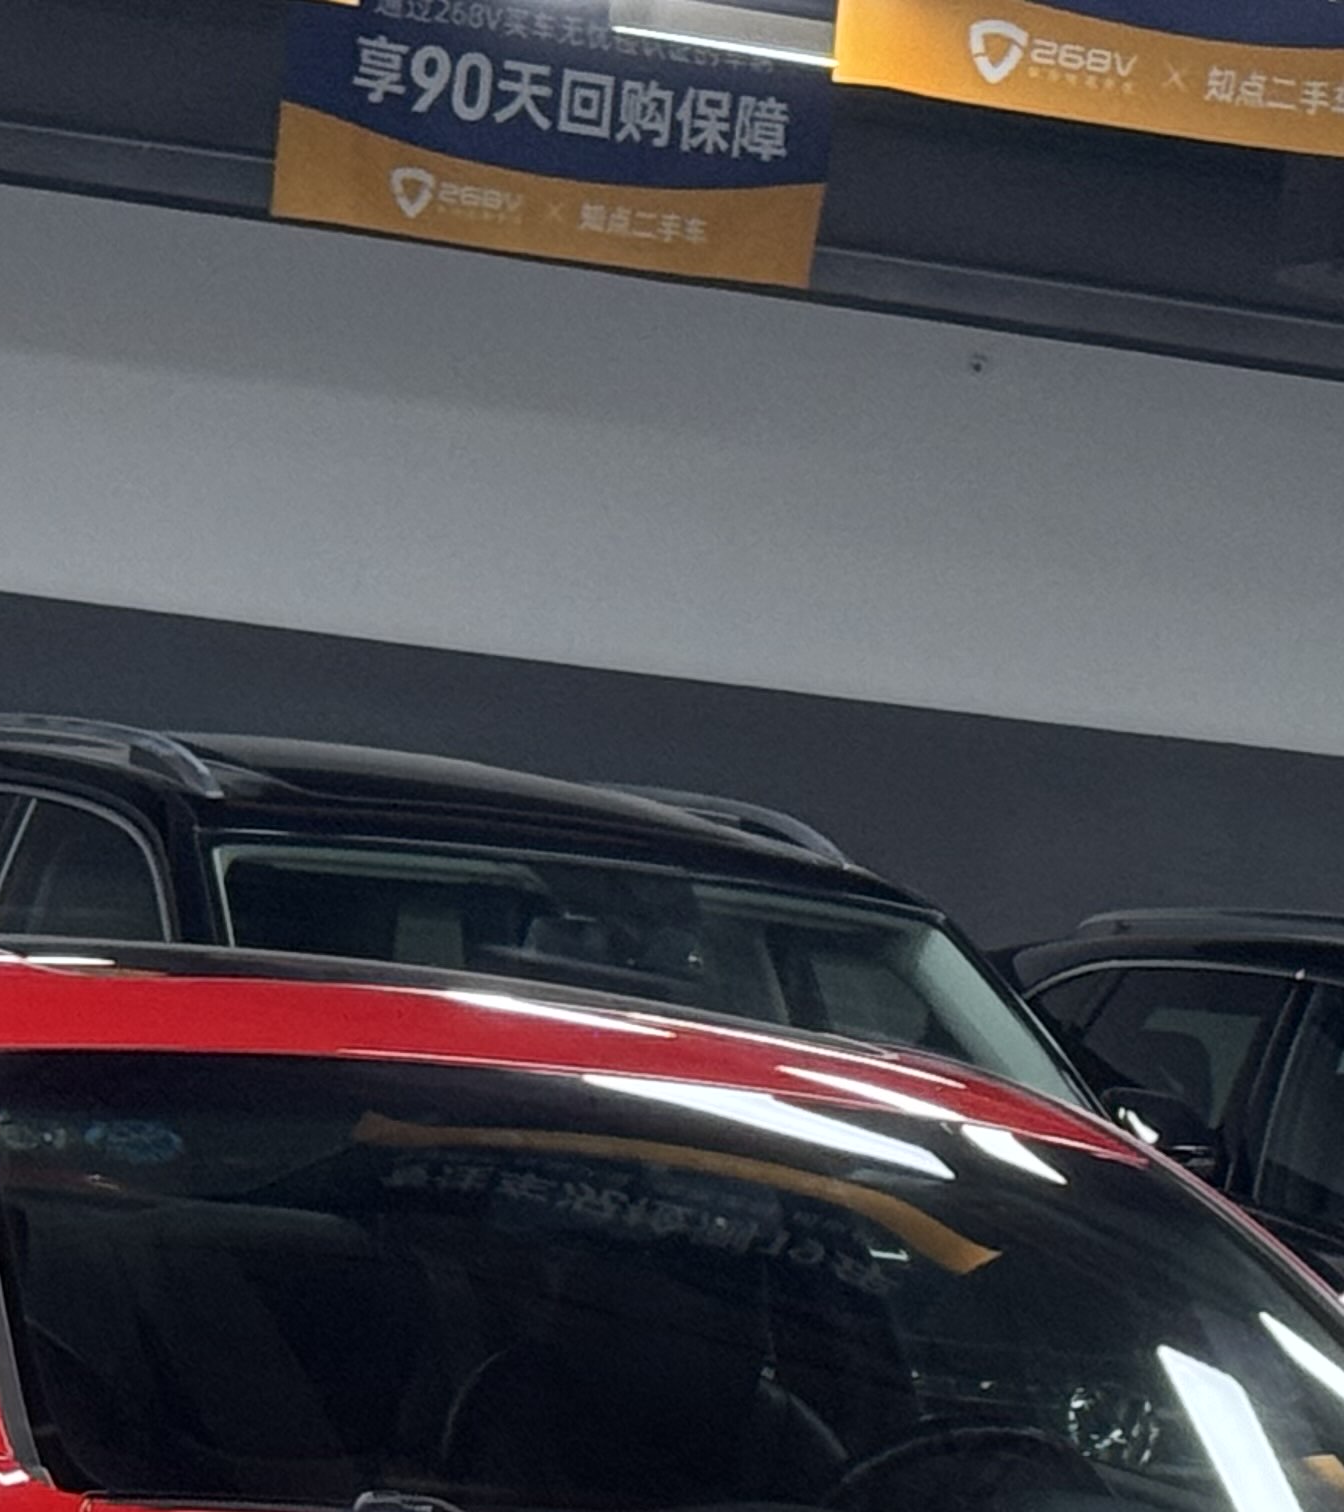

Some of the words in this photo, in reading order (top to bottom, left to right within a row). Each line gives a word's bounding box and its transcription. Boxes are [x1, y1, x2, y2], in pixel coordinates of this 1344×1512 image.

[1031, 38, 1139, 77] 268V
[352, 34, 791, 164] 享90天回购保障
[437, 181, 524, 213] 268V
[578, 201, 708, 245] 知点二手车
